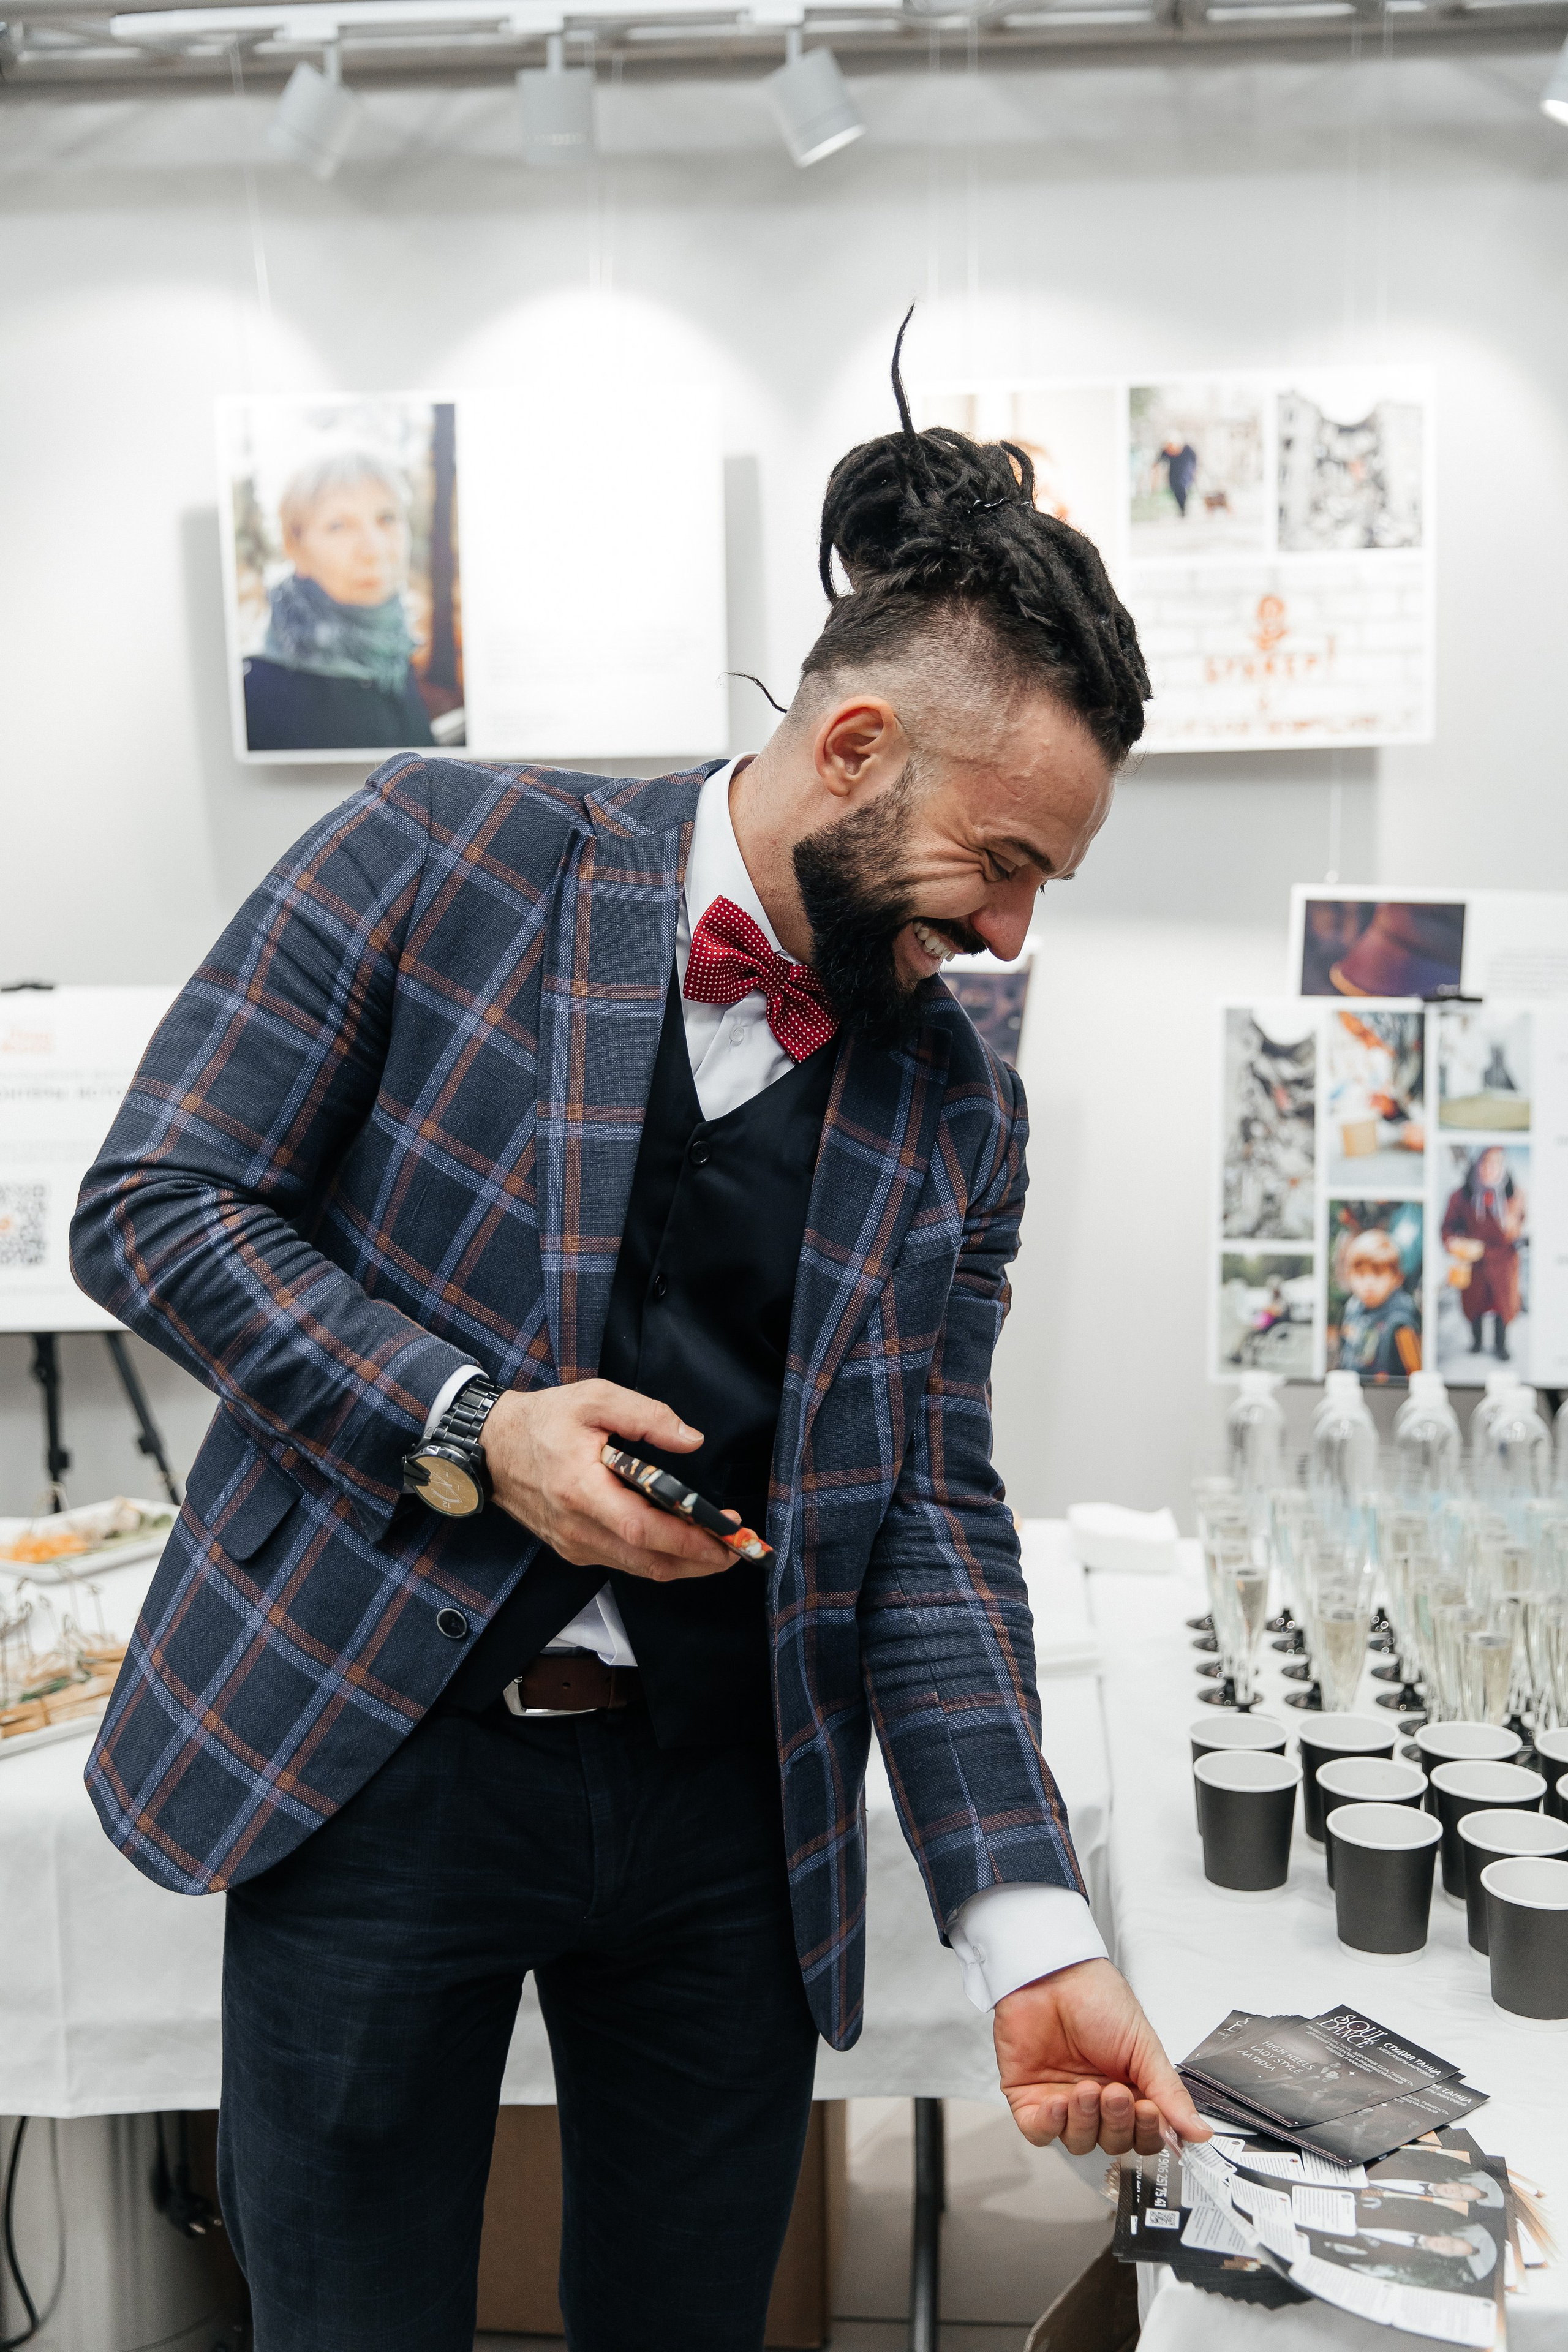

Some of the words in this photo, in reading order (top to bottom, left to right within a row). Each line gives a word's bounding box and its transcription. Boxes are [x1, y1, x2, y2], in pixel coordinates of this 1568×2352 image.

[1316, 2019, 1375, 2048] DANCE
[1333, 2015, 1388, 2042] SOUL
[1237, 2050, 1276, 2071] ЛАТИНА
[1250, 2045, 1278, 2059] LADY
[1273, 2058, 1303, 2075] STYLE
[1262, 2041, 1288, 2054] HIGH
[1285, 2053, 1316, 2070] HEELS
[1376, 2047, 1409, 2064] АЛЕКСАНДРЫ
[1408, 2064, 1435, 2079] ФИРСОВОЙ
[1384, 2043, 1416, 2060] СТУДИЯ
[1414, 2059, 1441, 2076] ТАНЦА
[1442, 2088, 1472, 2103] ТАНЦА
[1158, 2158, 1170, 2173] 906
[1155, 2187, 1167, 2198] 75
[1156, 2174, 1169, 2187] 251
[1155, 2198, 1167, 2207] 41
